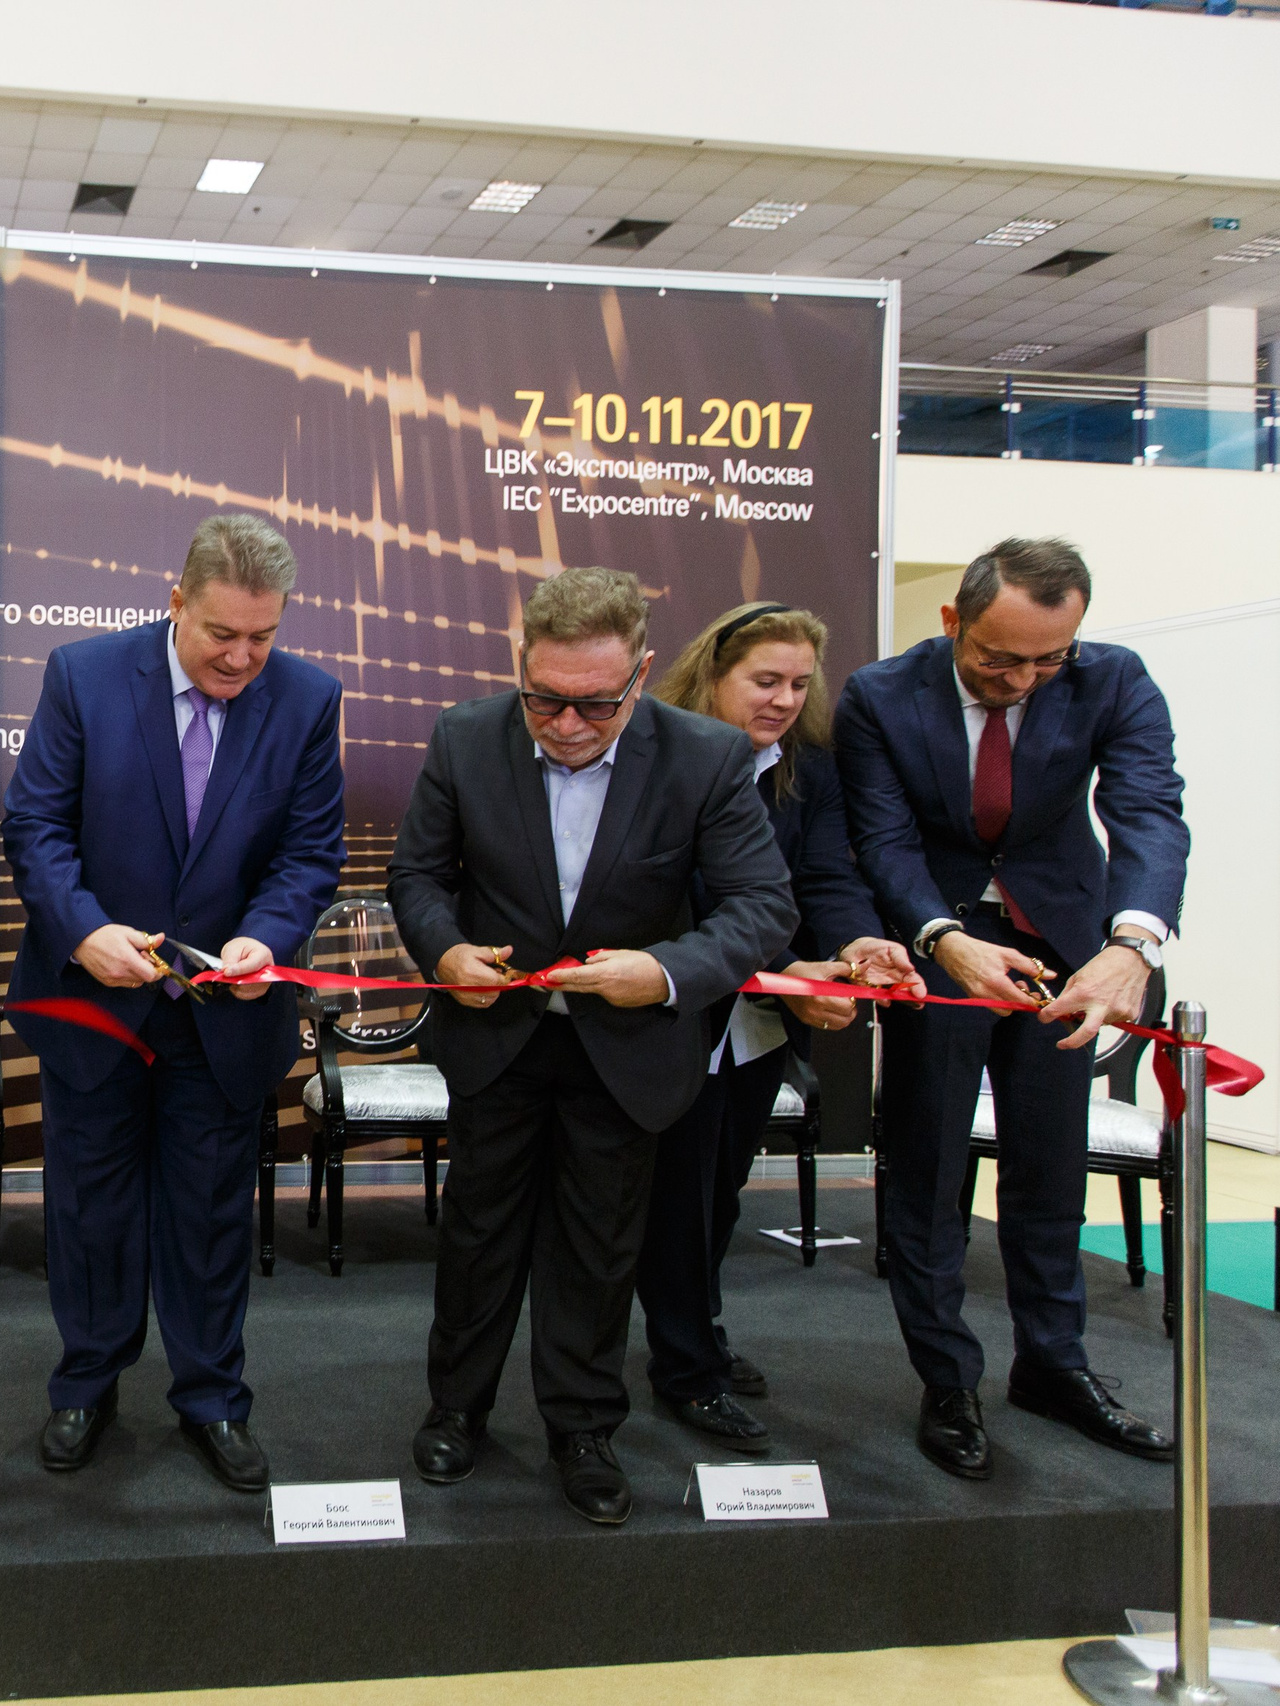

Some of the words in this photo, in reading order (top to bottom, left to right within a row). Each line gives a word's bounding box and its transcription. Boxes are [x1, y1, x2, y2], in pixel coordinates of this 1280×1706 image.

[484, 448, 538, 478] ЦВК
[543, 452, 716, 487] «Экспоцентр»,
[723, 458, 814, 487] Москва
[503, 486, 542, 512] IEC
[716, 495, 814, 521] Moscow
[742, 1487, 782, 1497] Назаров
[326, 1503, 350, 1513] Боос
[716, 1501, 744, 1514] Юрий
[746, 1502, 815, 1511] Владимирович
[283, 1518, 324, 1531] Георгий
[326, 1517, 396, 1528] Валентинович
